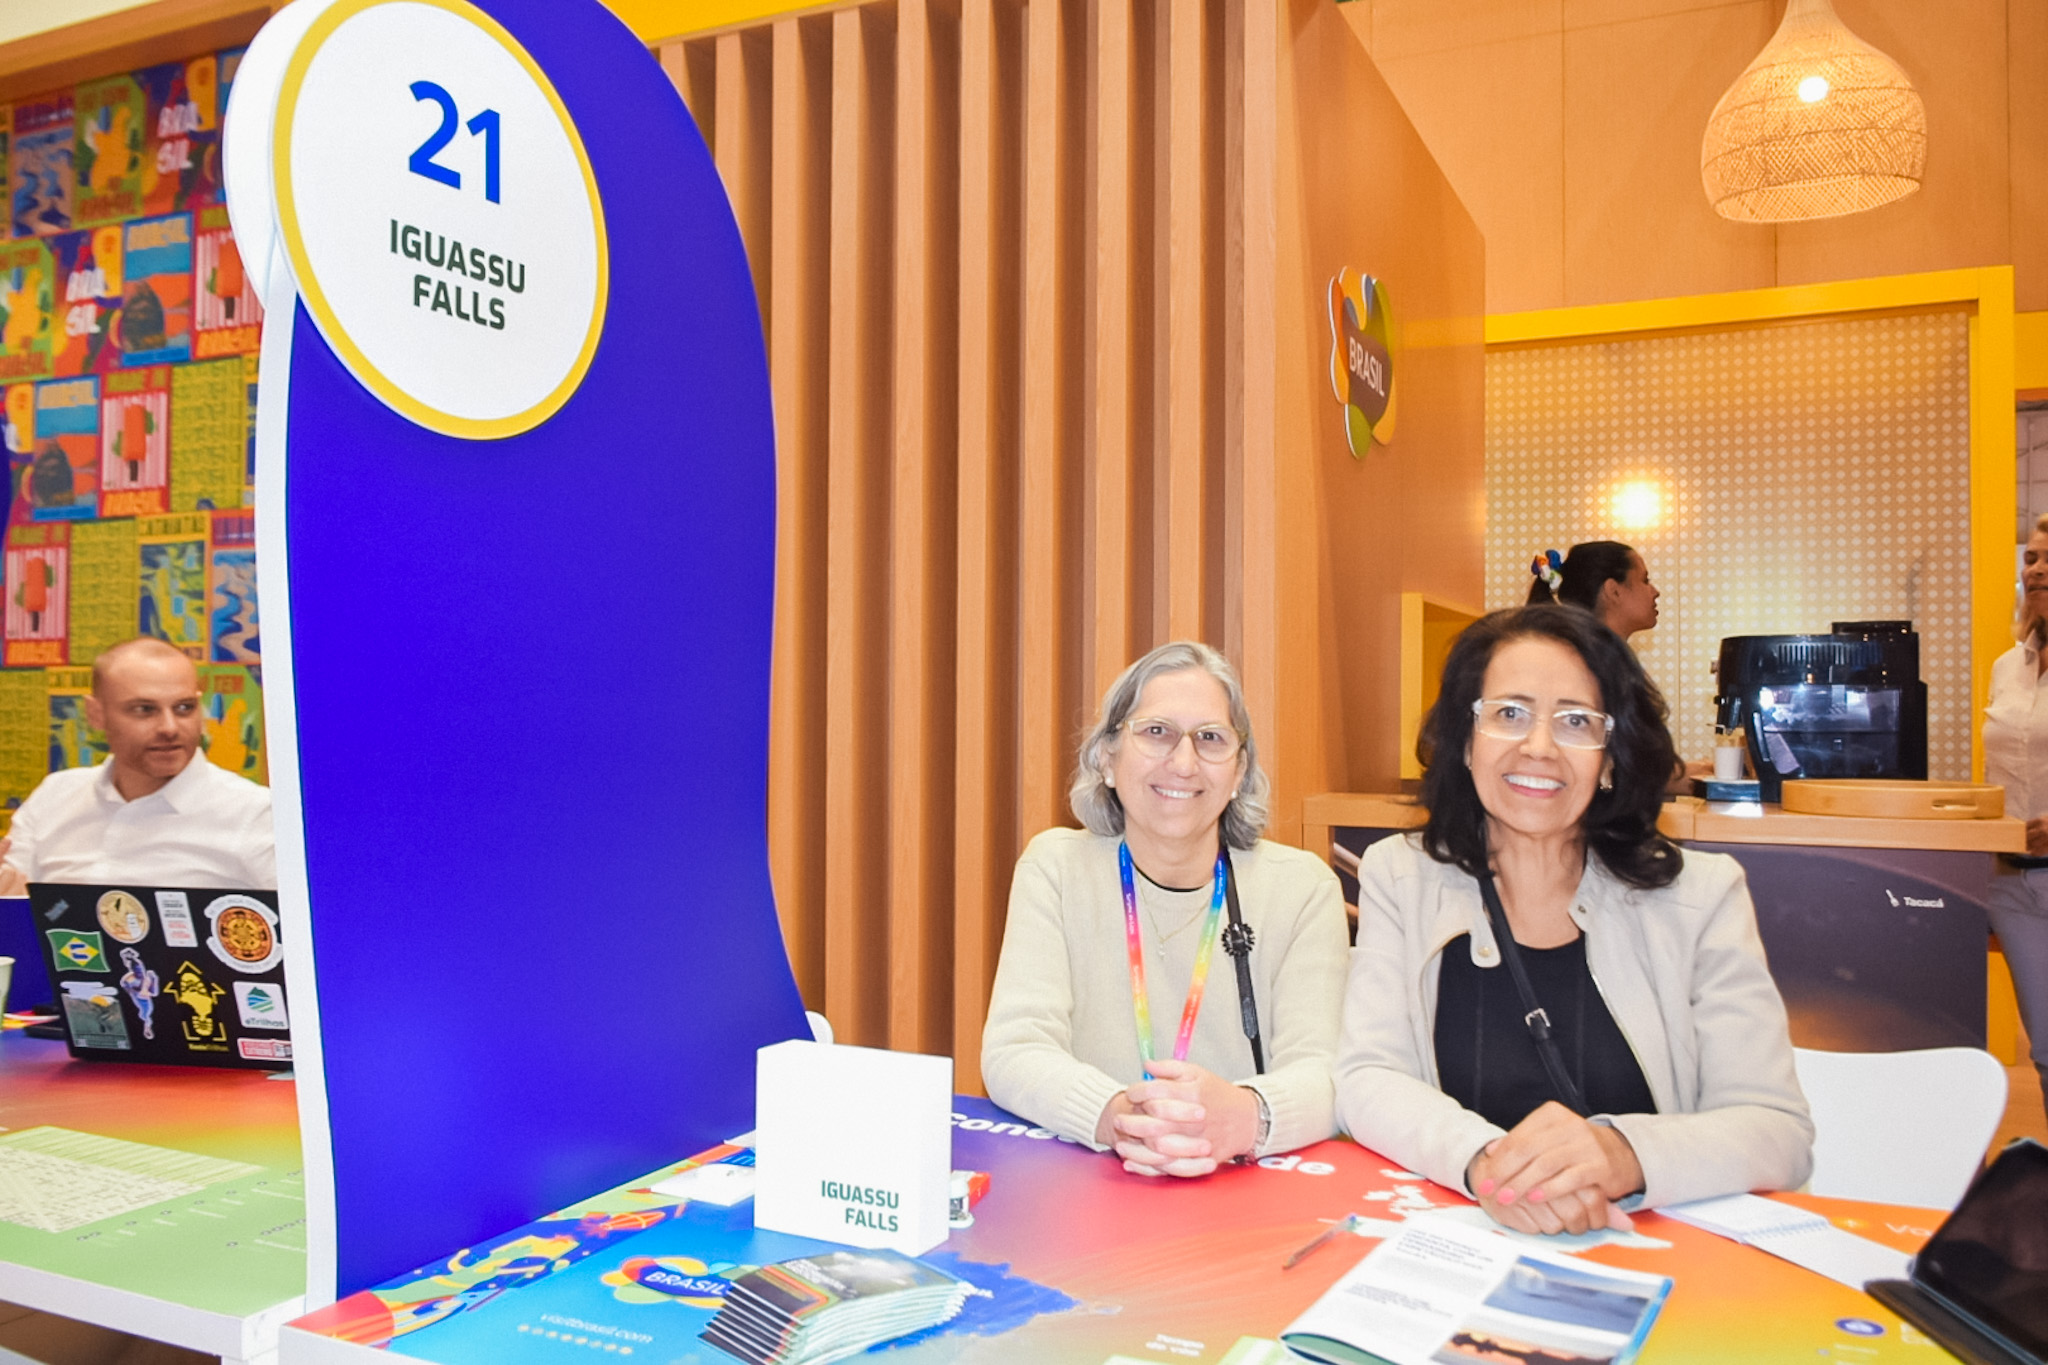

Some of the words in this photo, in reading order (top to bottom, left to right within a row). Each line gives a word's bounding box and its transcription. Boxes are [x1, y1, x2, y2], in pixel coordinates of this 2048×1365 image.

[409, 80, 500, 205] 21
[391, 218, 525, 294] IGUASSU
[413, 274, 505, 331] FALLS
[1350, 336, 1384, 397] BRASIL
[821, 1180, 899, 1209] IGUASSU
[845, 1208, 899, 1233] FALLS
[645, 1272, 727, 1295] BRASIL
